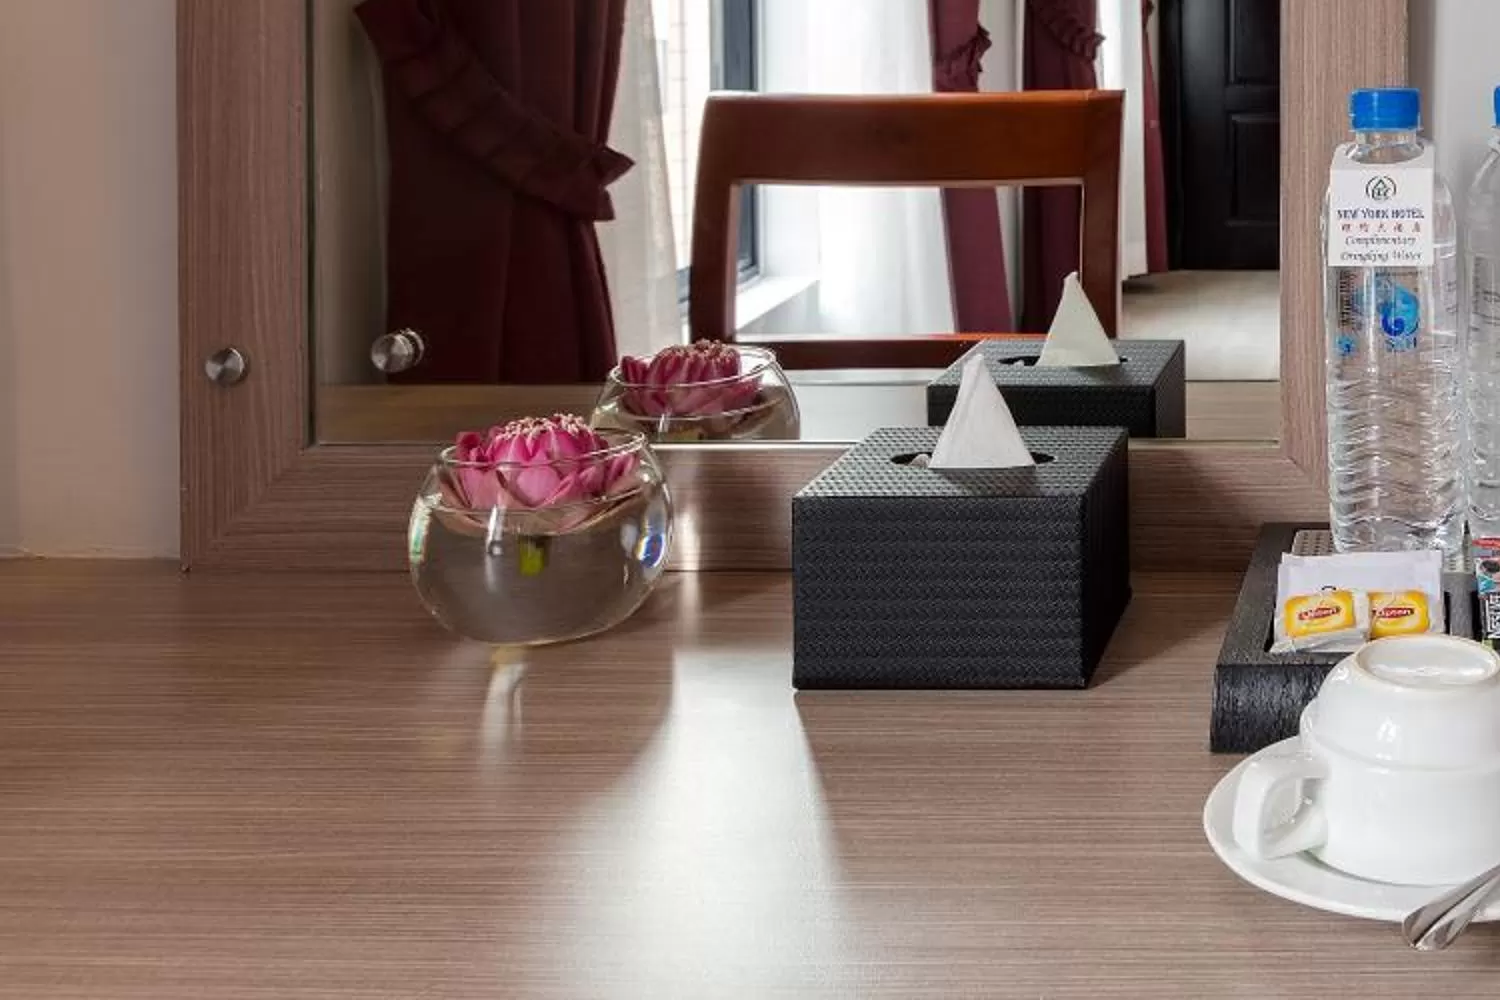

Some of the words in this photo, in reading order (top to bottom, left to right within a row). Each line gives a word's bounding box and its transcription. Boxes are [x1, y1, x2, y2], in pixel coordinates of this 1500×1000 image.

[1337, 207, 1359, 219] NEW
[1361, 207, 1389, 219] YORK
[1391, 208, 1425, 219] HOTEL
